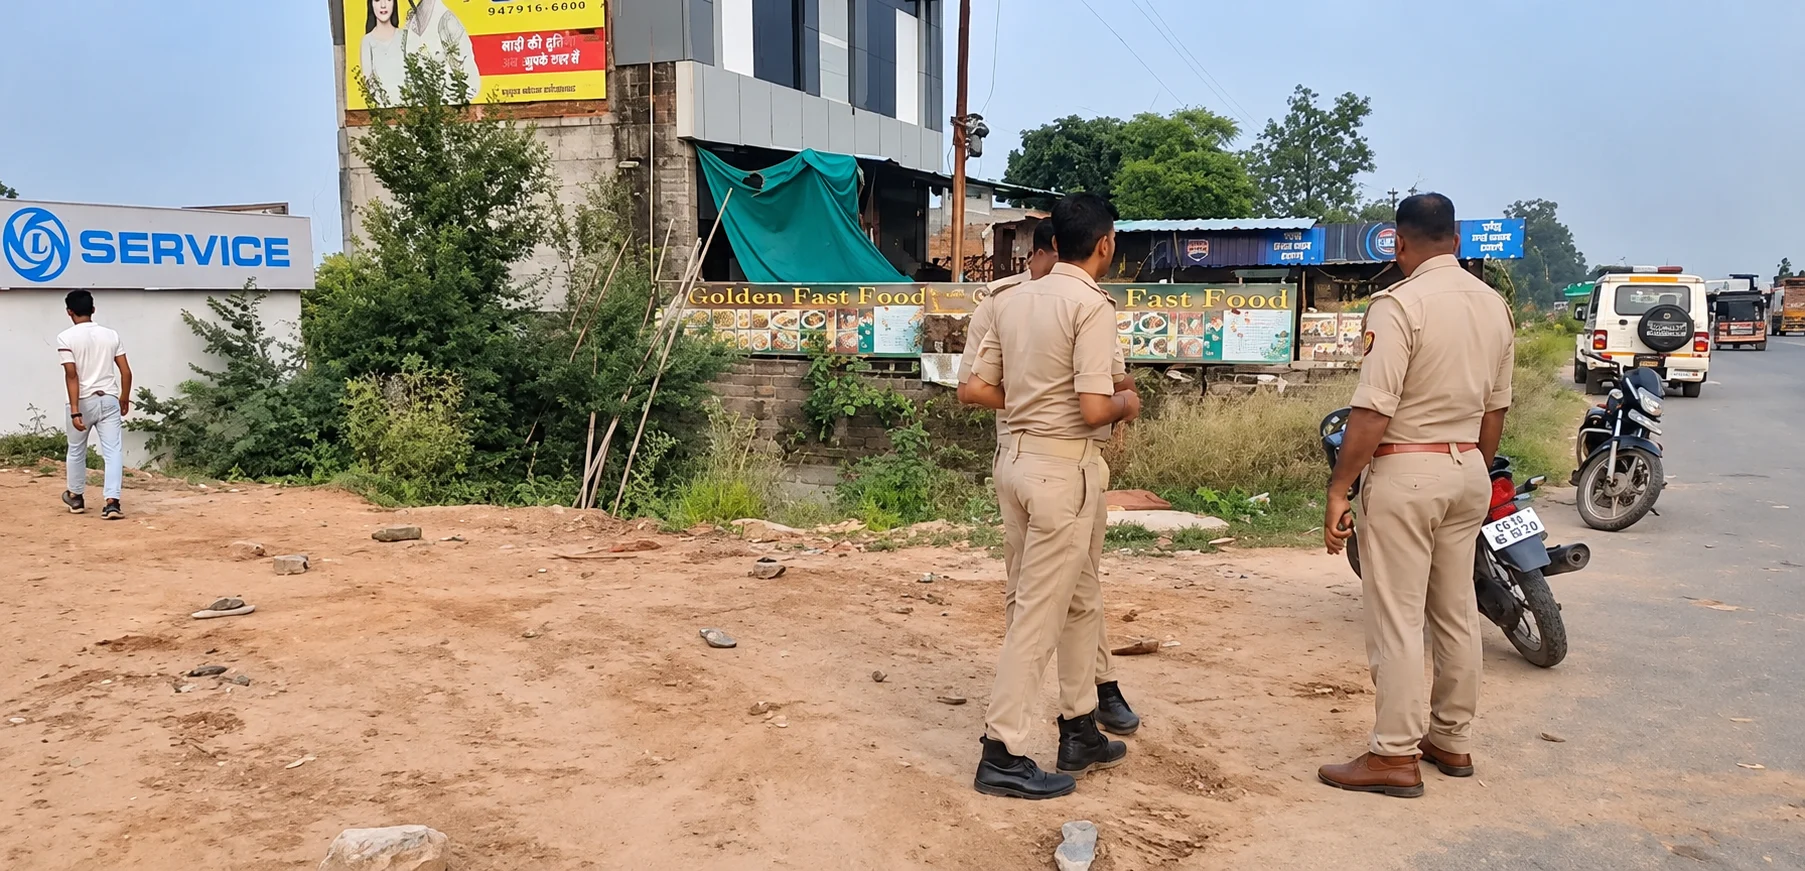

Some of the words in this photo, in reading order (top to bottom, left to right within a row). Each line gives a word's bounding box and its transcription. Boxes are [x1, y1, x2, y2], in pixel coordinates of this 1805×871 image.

[79, 230, 290, 267] SERVICE
[689, 287, 784, 305] Golden
[792, 287, 850, 305] Fast
[858, 286, 926, 305] Food
[1125, 288, 1192, 308] Fast
[1202, 288, 1288, 309] Food
